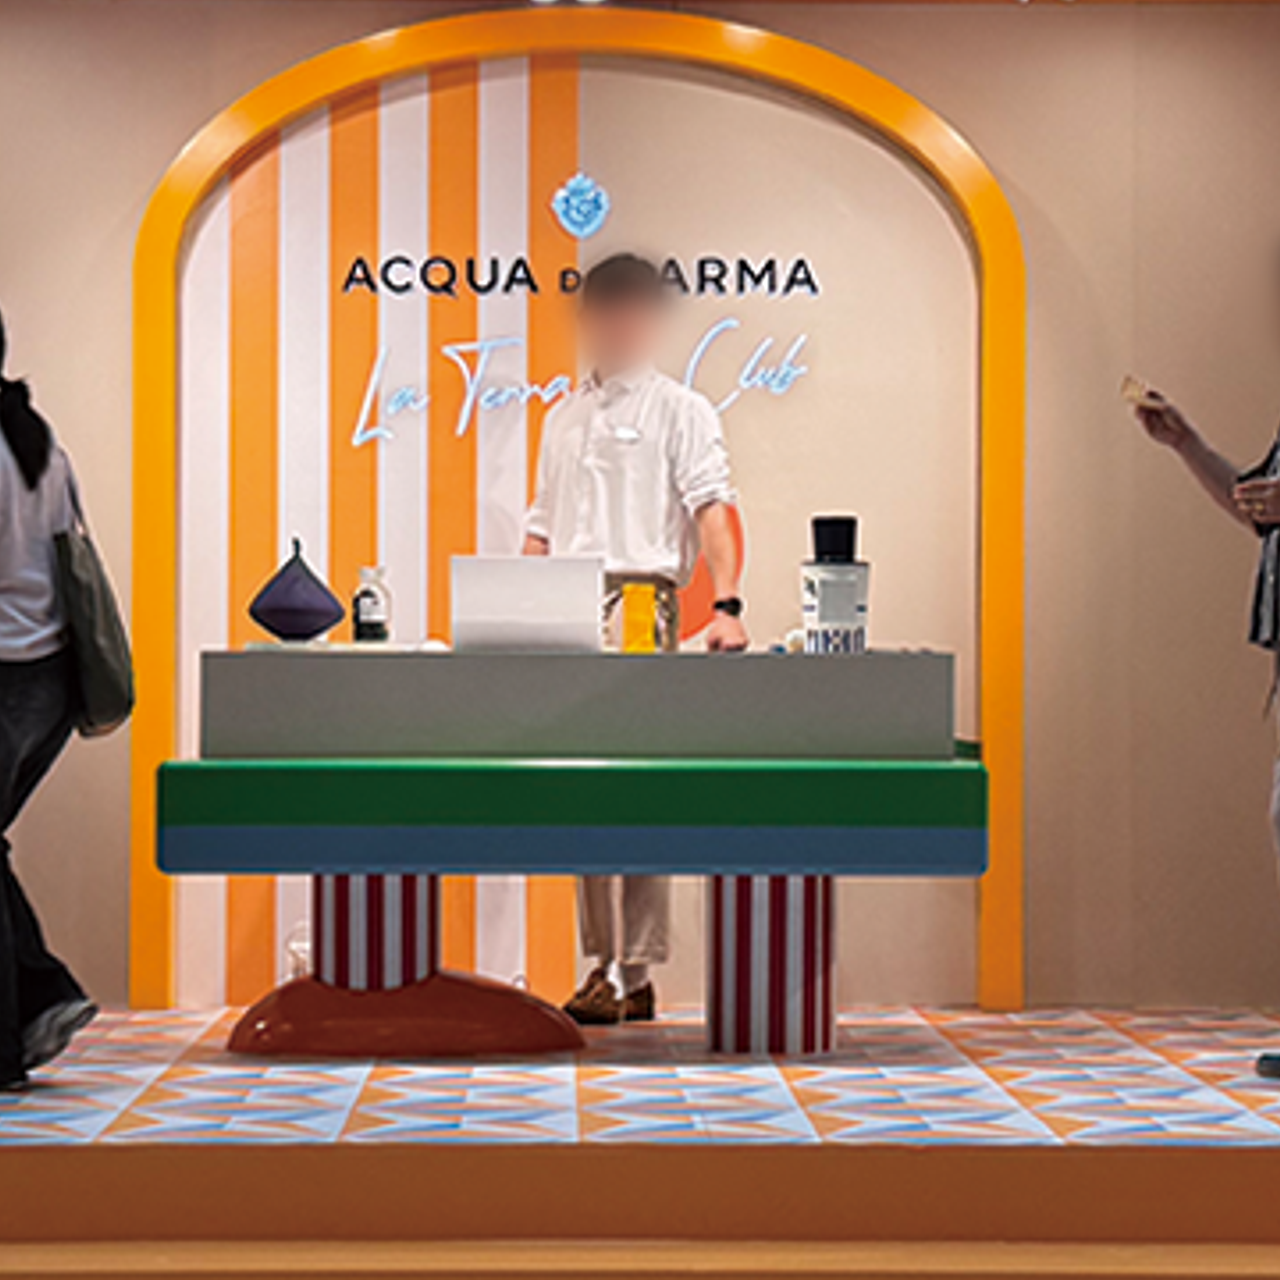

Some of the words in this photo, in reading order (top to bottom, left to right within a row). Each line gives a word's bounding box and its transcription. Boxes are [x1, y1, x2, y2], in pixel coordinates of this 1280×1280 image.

[342, 257, 539, 298] ACQUA
[559, 267, 583, 294] D
[660, 257, 820, 296] ARMA
[351, 342, 430, 448] La
[682, 316, 808, 416] Club
